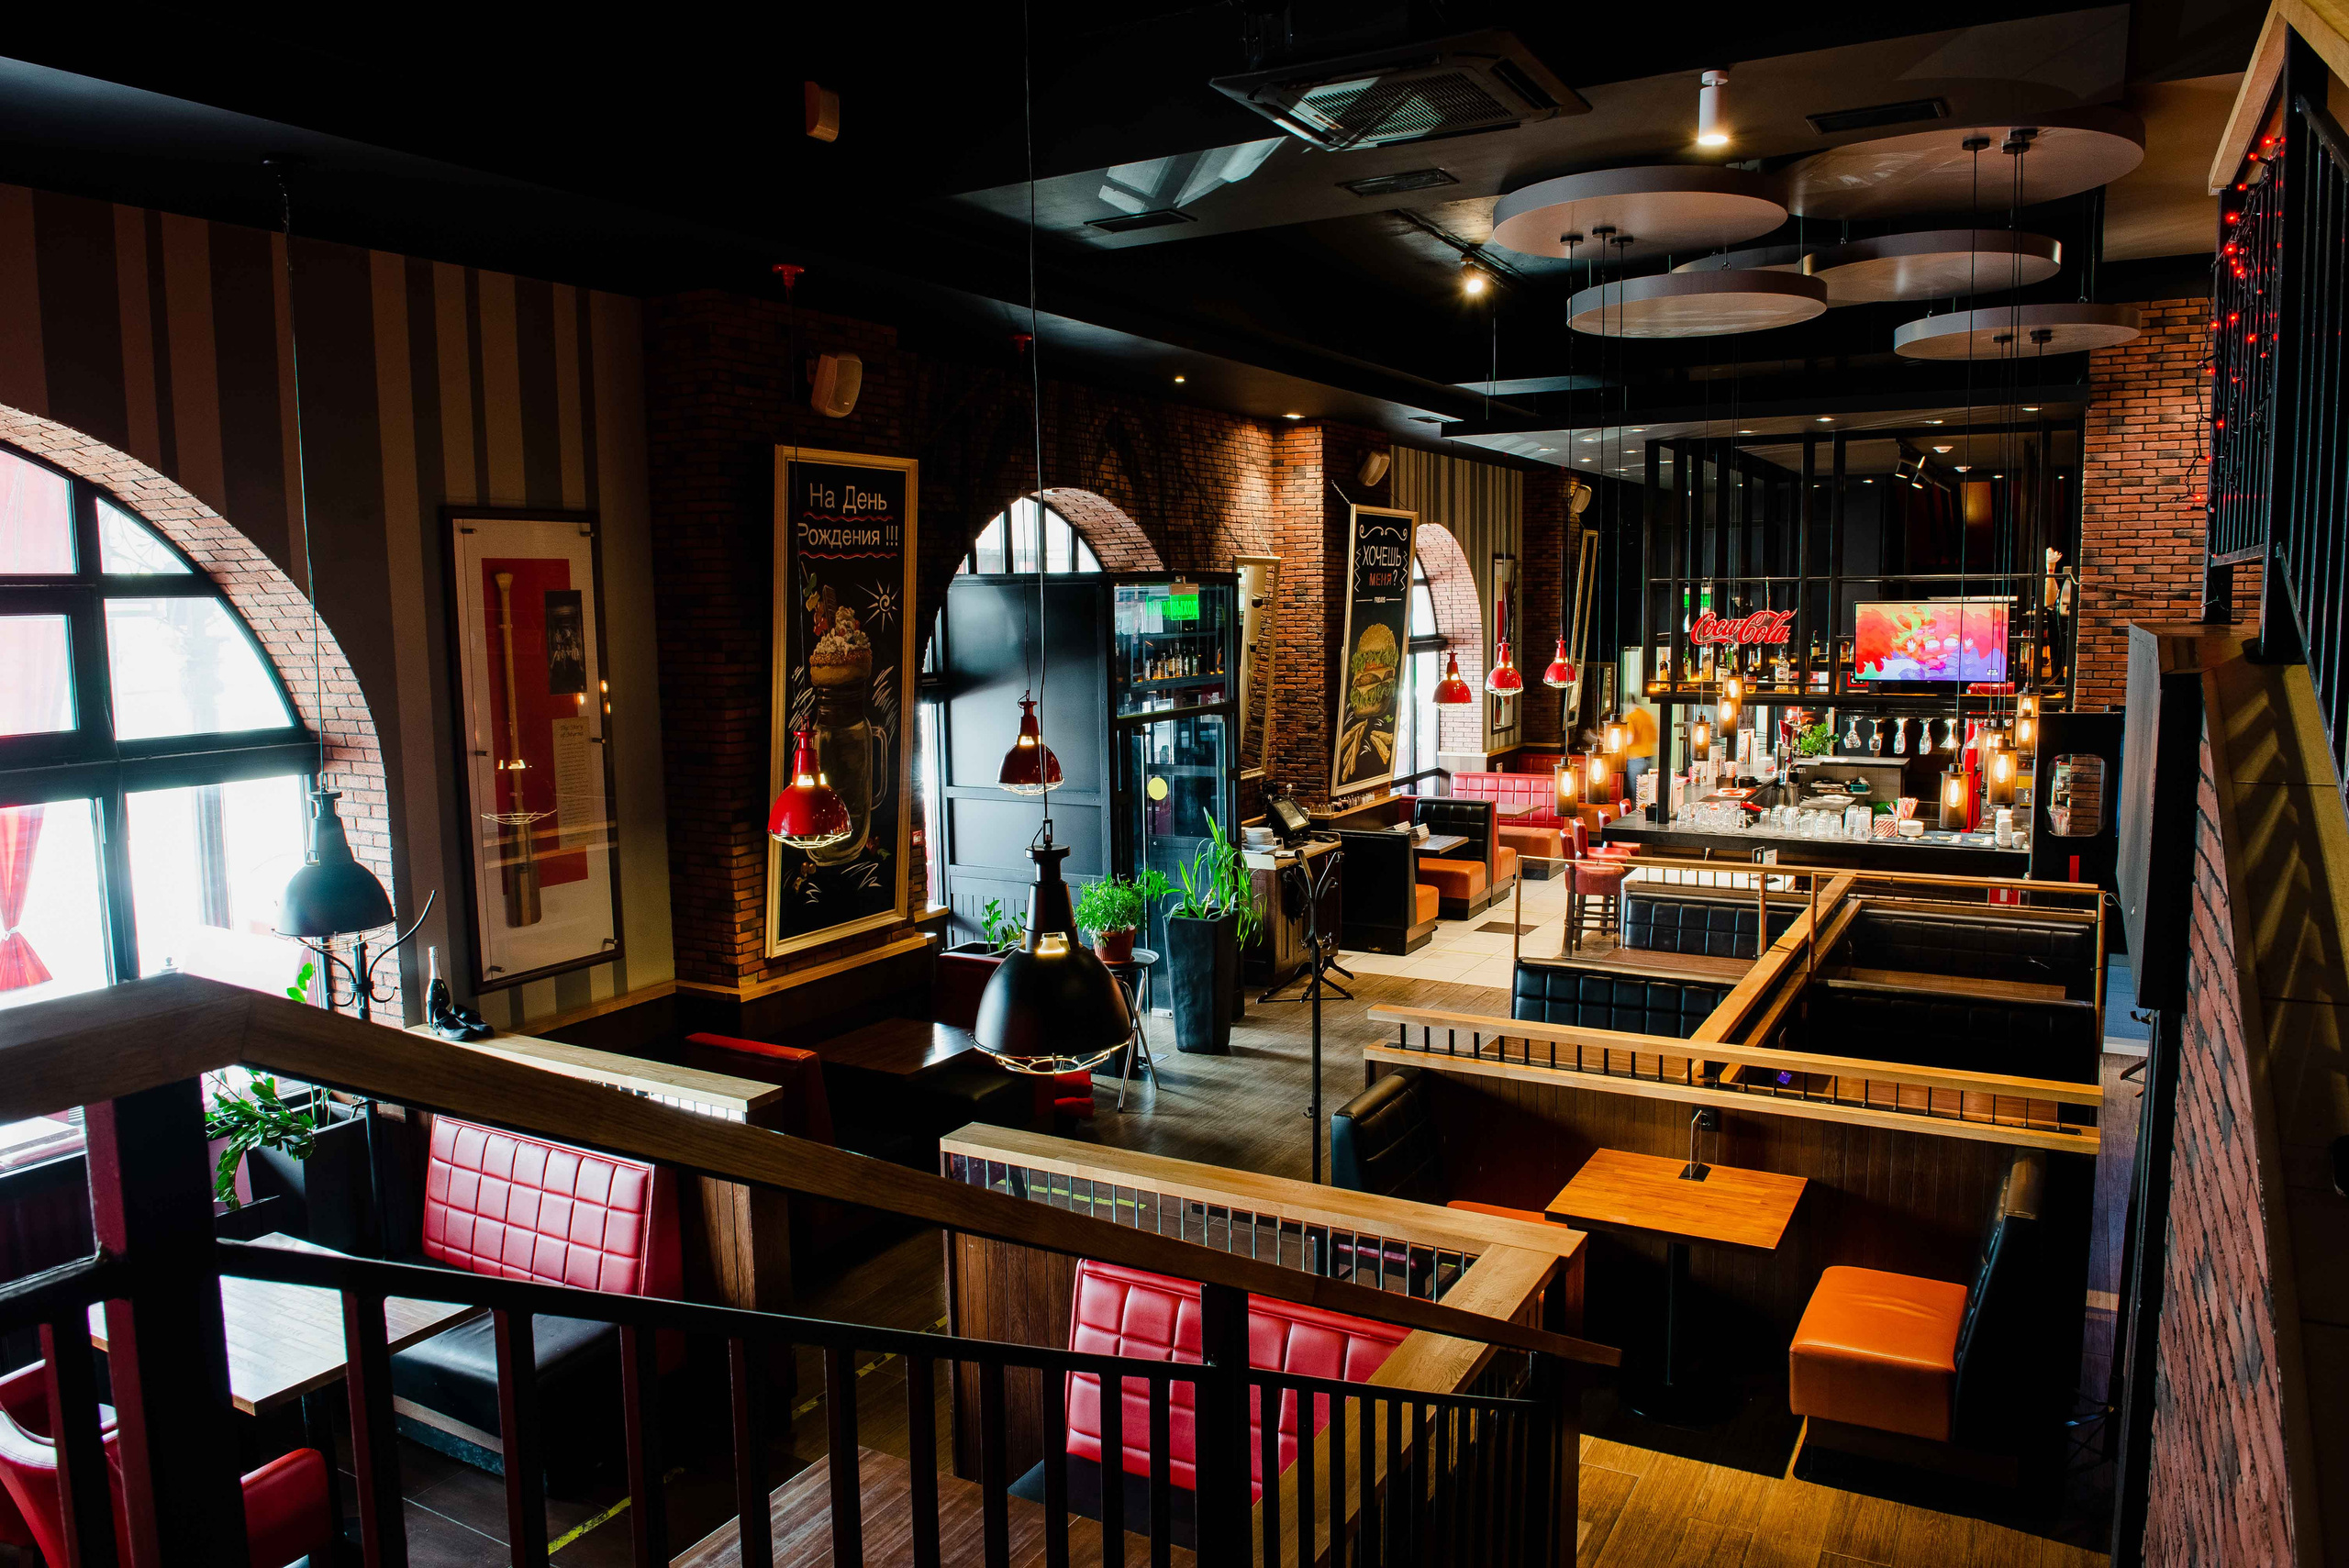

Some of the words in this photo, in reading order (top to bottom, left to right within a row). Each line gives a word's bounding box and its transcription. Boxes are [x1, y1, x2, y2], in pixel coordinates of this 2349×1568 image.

[809, 483, 835, 508] На
[842, 485, 887, 514] День
[797, 522, 880, 549] Рождения
[885, 525, 898, 547] !!!
[1363, 545, 1402, 567] ХОЧЕШЬ
[1171, 600, 1198, 617] ВЫХОД
